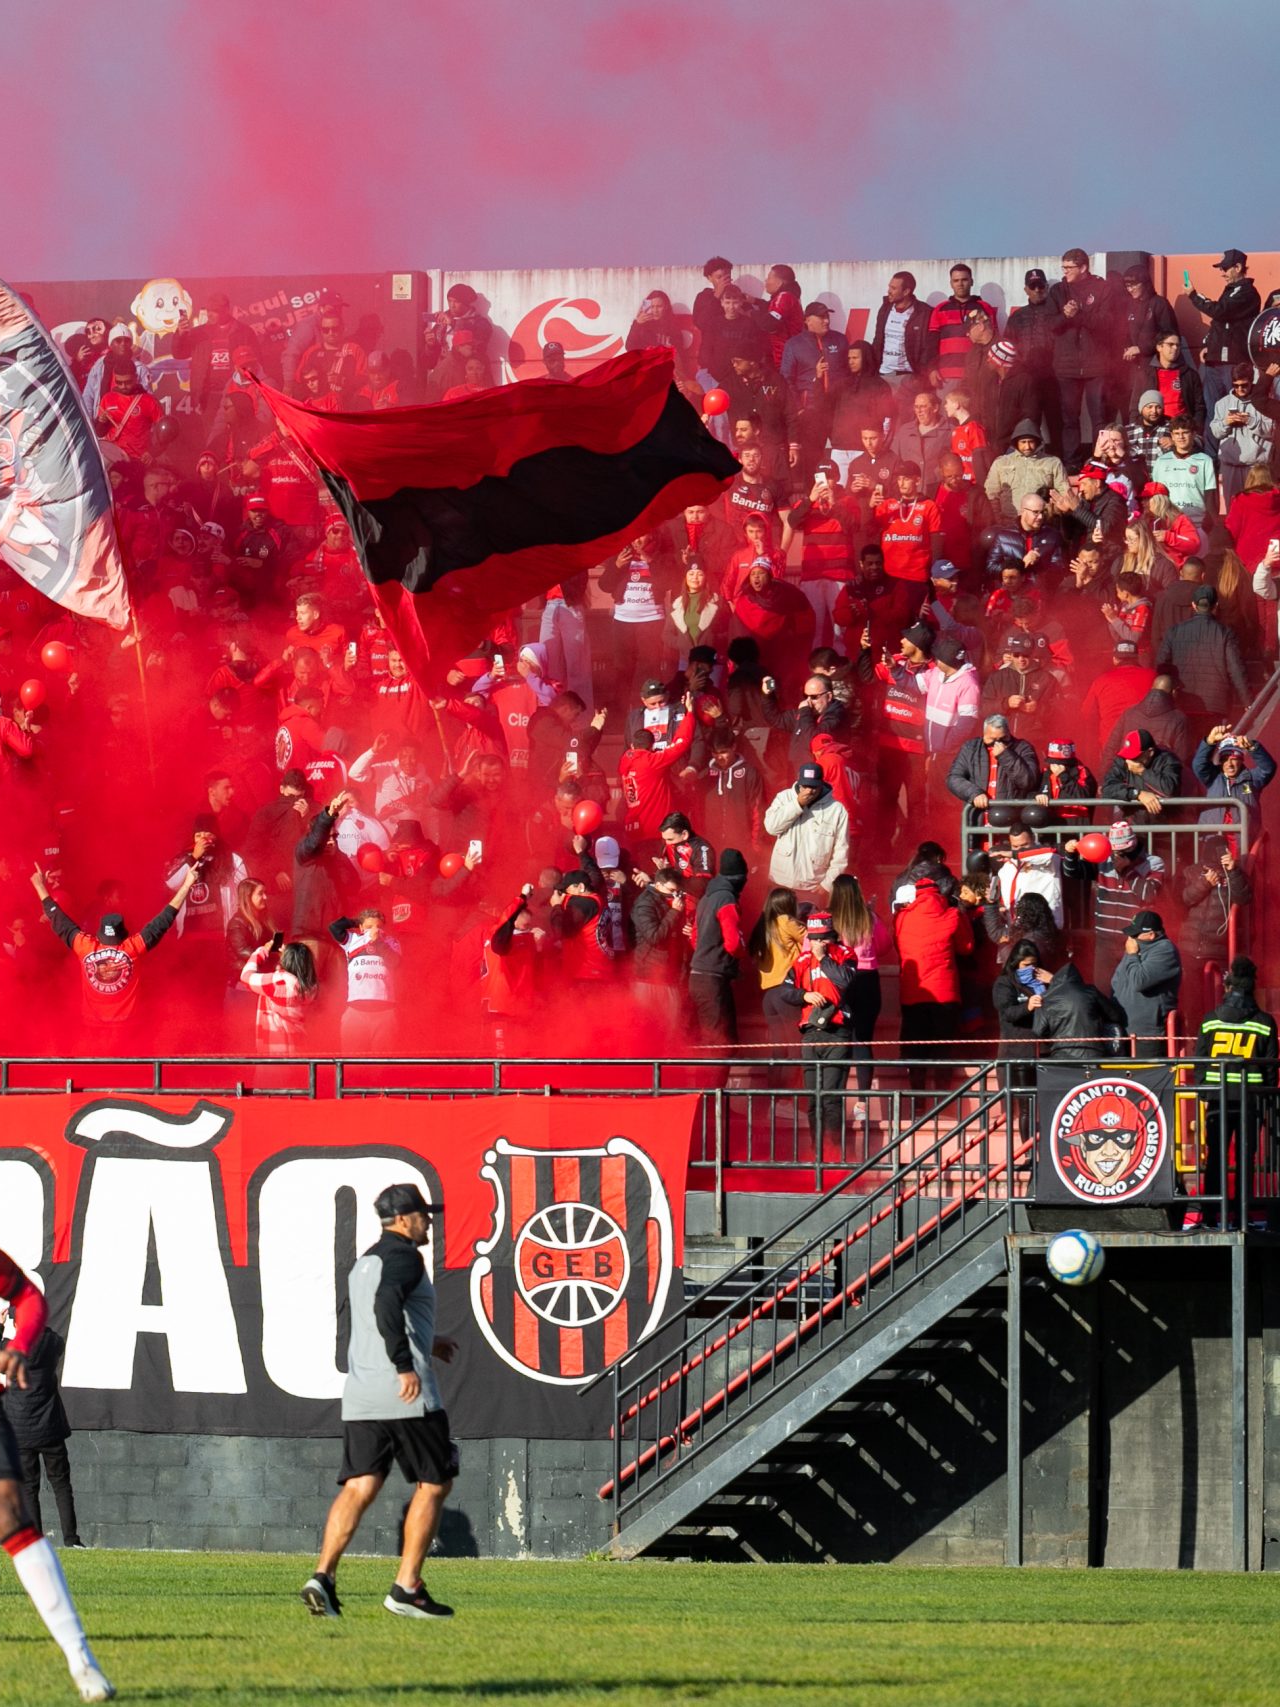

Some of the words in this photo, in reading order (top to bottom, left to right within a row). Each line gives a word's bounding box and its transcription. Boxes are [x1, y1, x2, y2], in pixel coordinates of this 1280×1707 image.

[1211, 1031, 1257, 1058] 24
[1058, 1085, 1127, 1138] COMANDO
[1074, 1173, 1128, 1196] RUBRO
[1134, 1121, 1159, 1180] NEGRO
[531, 1251, 613, 1279] GEB
